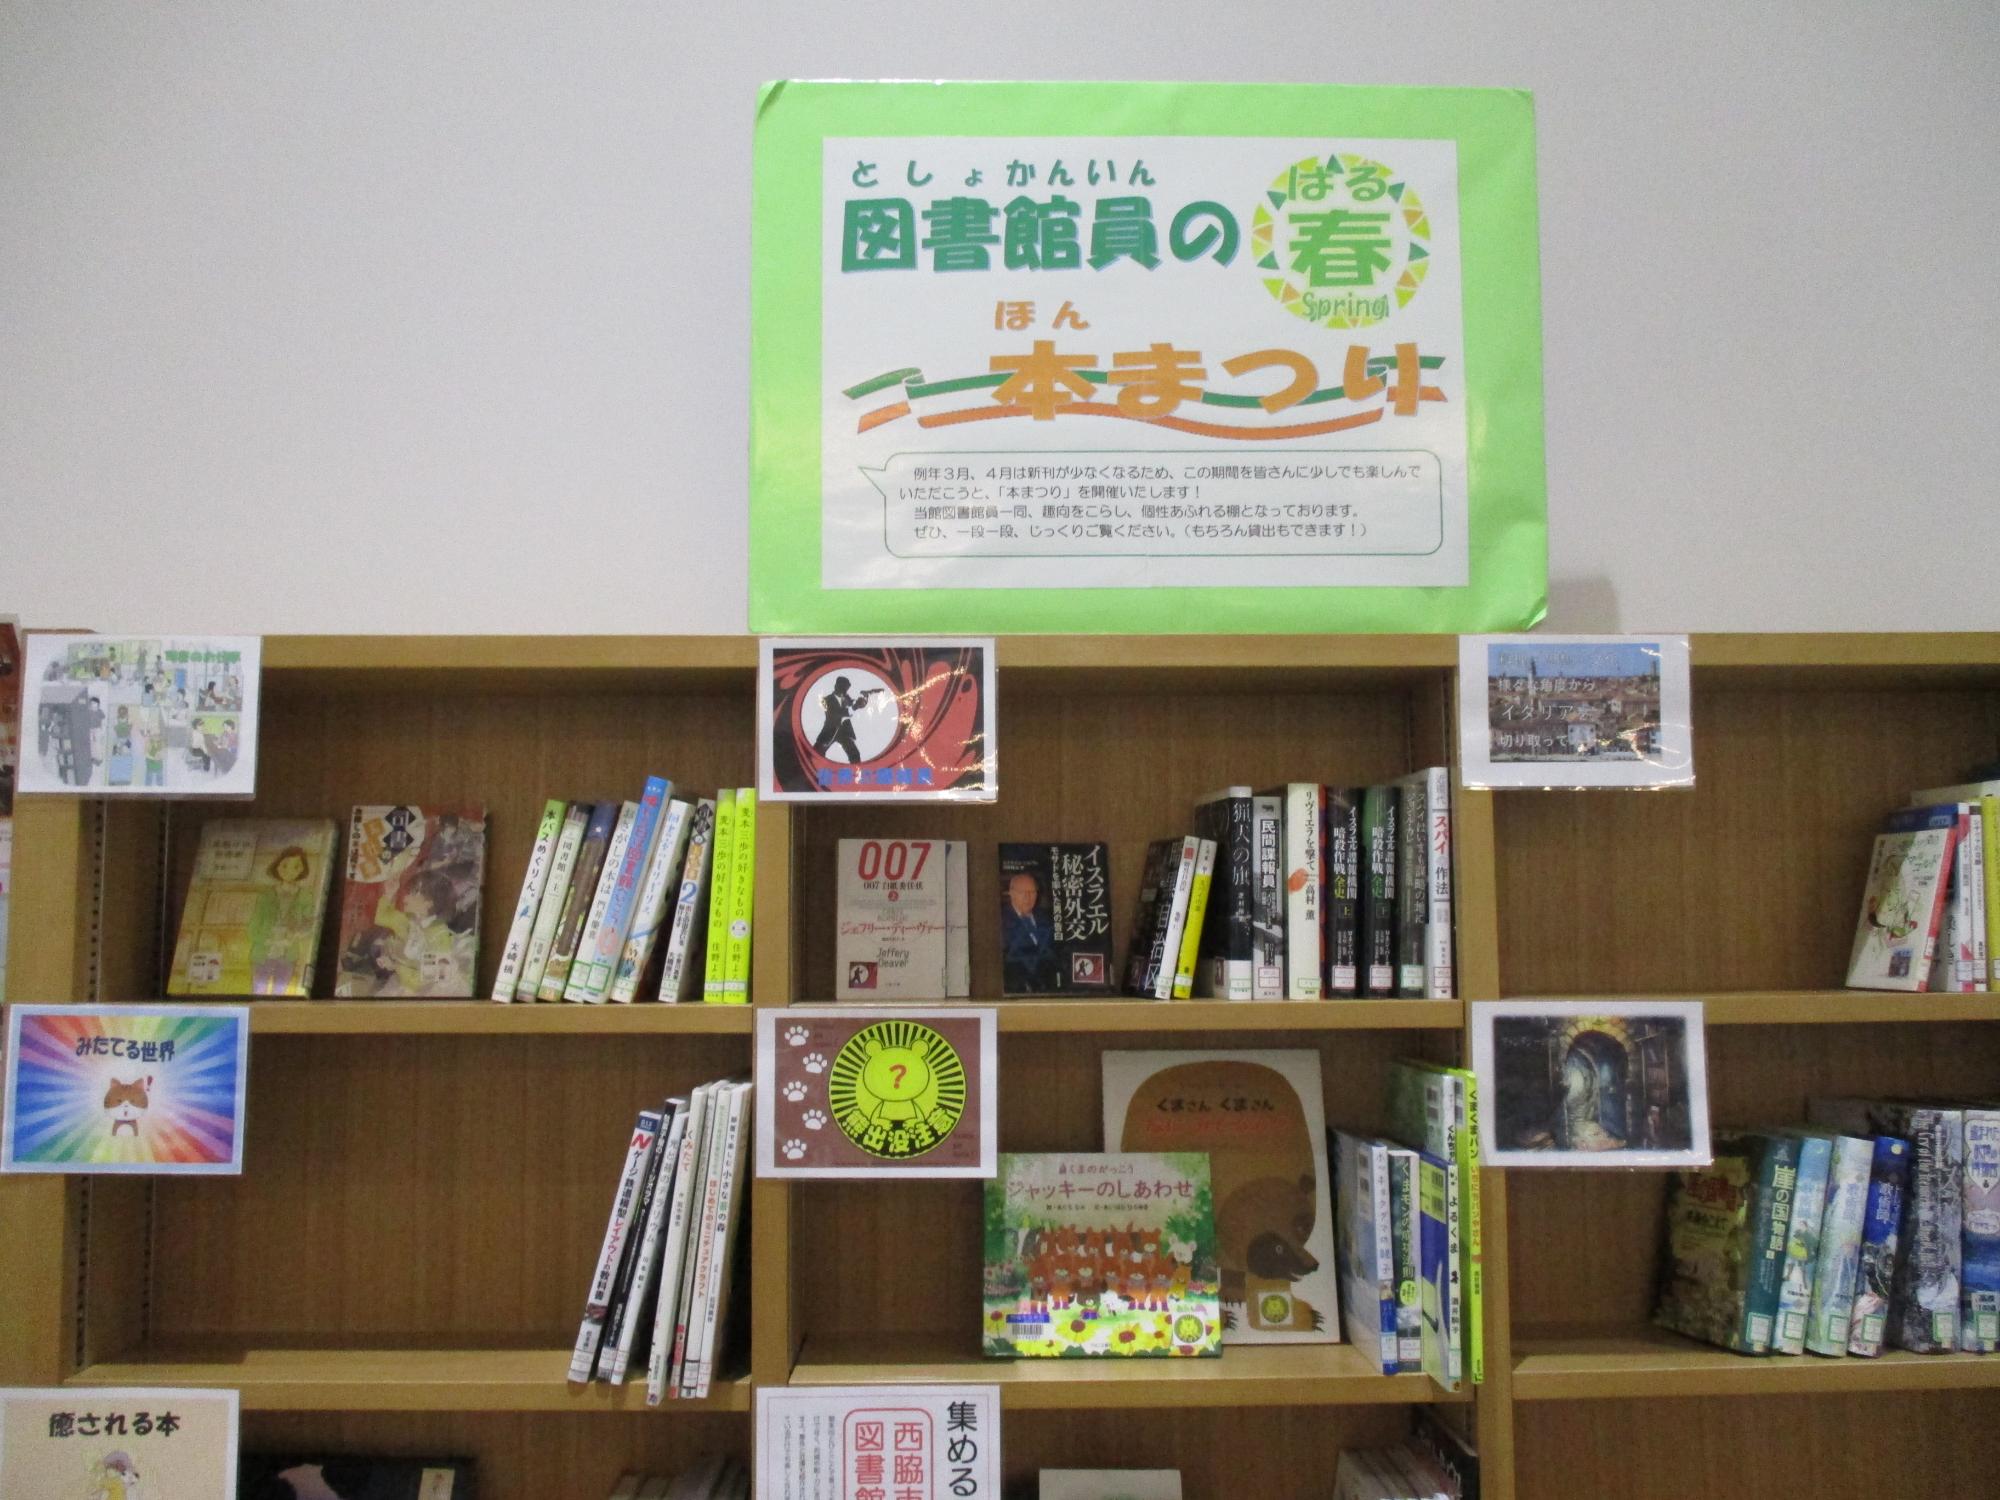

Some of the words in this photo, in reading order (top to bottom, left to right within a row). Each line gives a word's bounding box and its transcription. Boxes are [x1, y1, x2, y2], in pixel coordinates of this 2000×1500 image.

[852, 158, 1156, 187] としょかんいん
[1289, 163, 1387, 201] はる
[842, 195, 1240, 274] 図書館員の
[1289, 210, 1392, 288] 春
[995, 302, 1090, 329] ほん
[1302, 293, 1389, 320] Spring
[990, 340, 1419, 419] 本まつり
[1501, 734, 1568, 747] 切り取って
[858, 842, 931, 880] 007
[1261, 820, 1277, 888] 民間諜報員
[1304, 791, 1316, 871] リヴィエラを撃て
[1333, 827, 1346, 899] 暗殺作戦全史
[1062, 853, 1087, 941] 秘密外交
[1084, 845, 1109, 935] イスラエル
[76, 1036, 175, 1062] みたてる世界
[1007, 1179, 1193, 1200] ジャッキーのしあわせ
[1770, 1165, 1796, 1251] 崖の国物語
[50, 1412, 180, 1437] 癒される本
[947, 1401, 977, 1497] 集める
